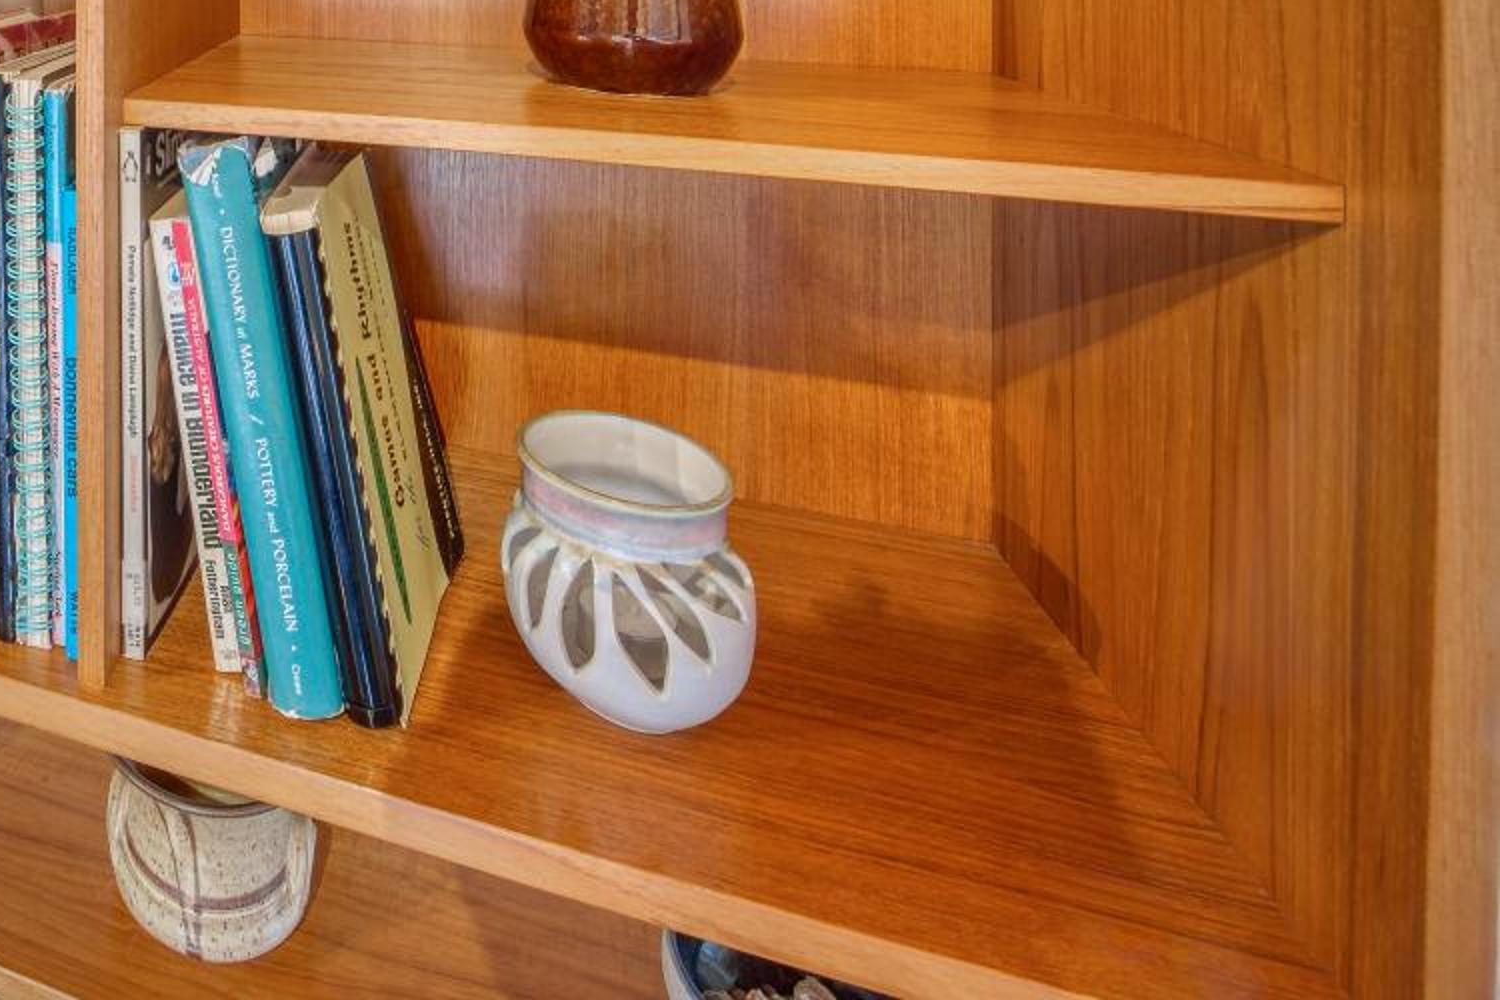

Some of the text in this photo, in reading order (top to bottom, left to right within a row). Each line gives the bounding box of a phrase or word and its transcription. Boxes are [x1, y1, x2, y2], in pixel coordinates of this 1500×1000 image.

[220, 227, 246, 323] DICTIONARY
[343, 221, 372, 340] Rhythms
[238, 343, 261, 399] MARKS
[366, 354, 383, 402] and
[64, 357, 77, 498] bonneville cars
[255, 438, 278, 507] POTTERY
[184, 416, 222, 549] Blunderland
[266, 512, 279, 534] and
[272, 538, 299, 632] PORCELAIN
